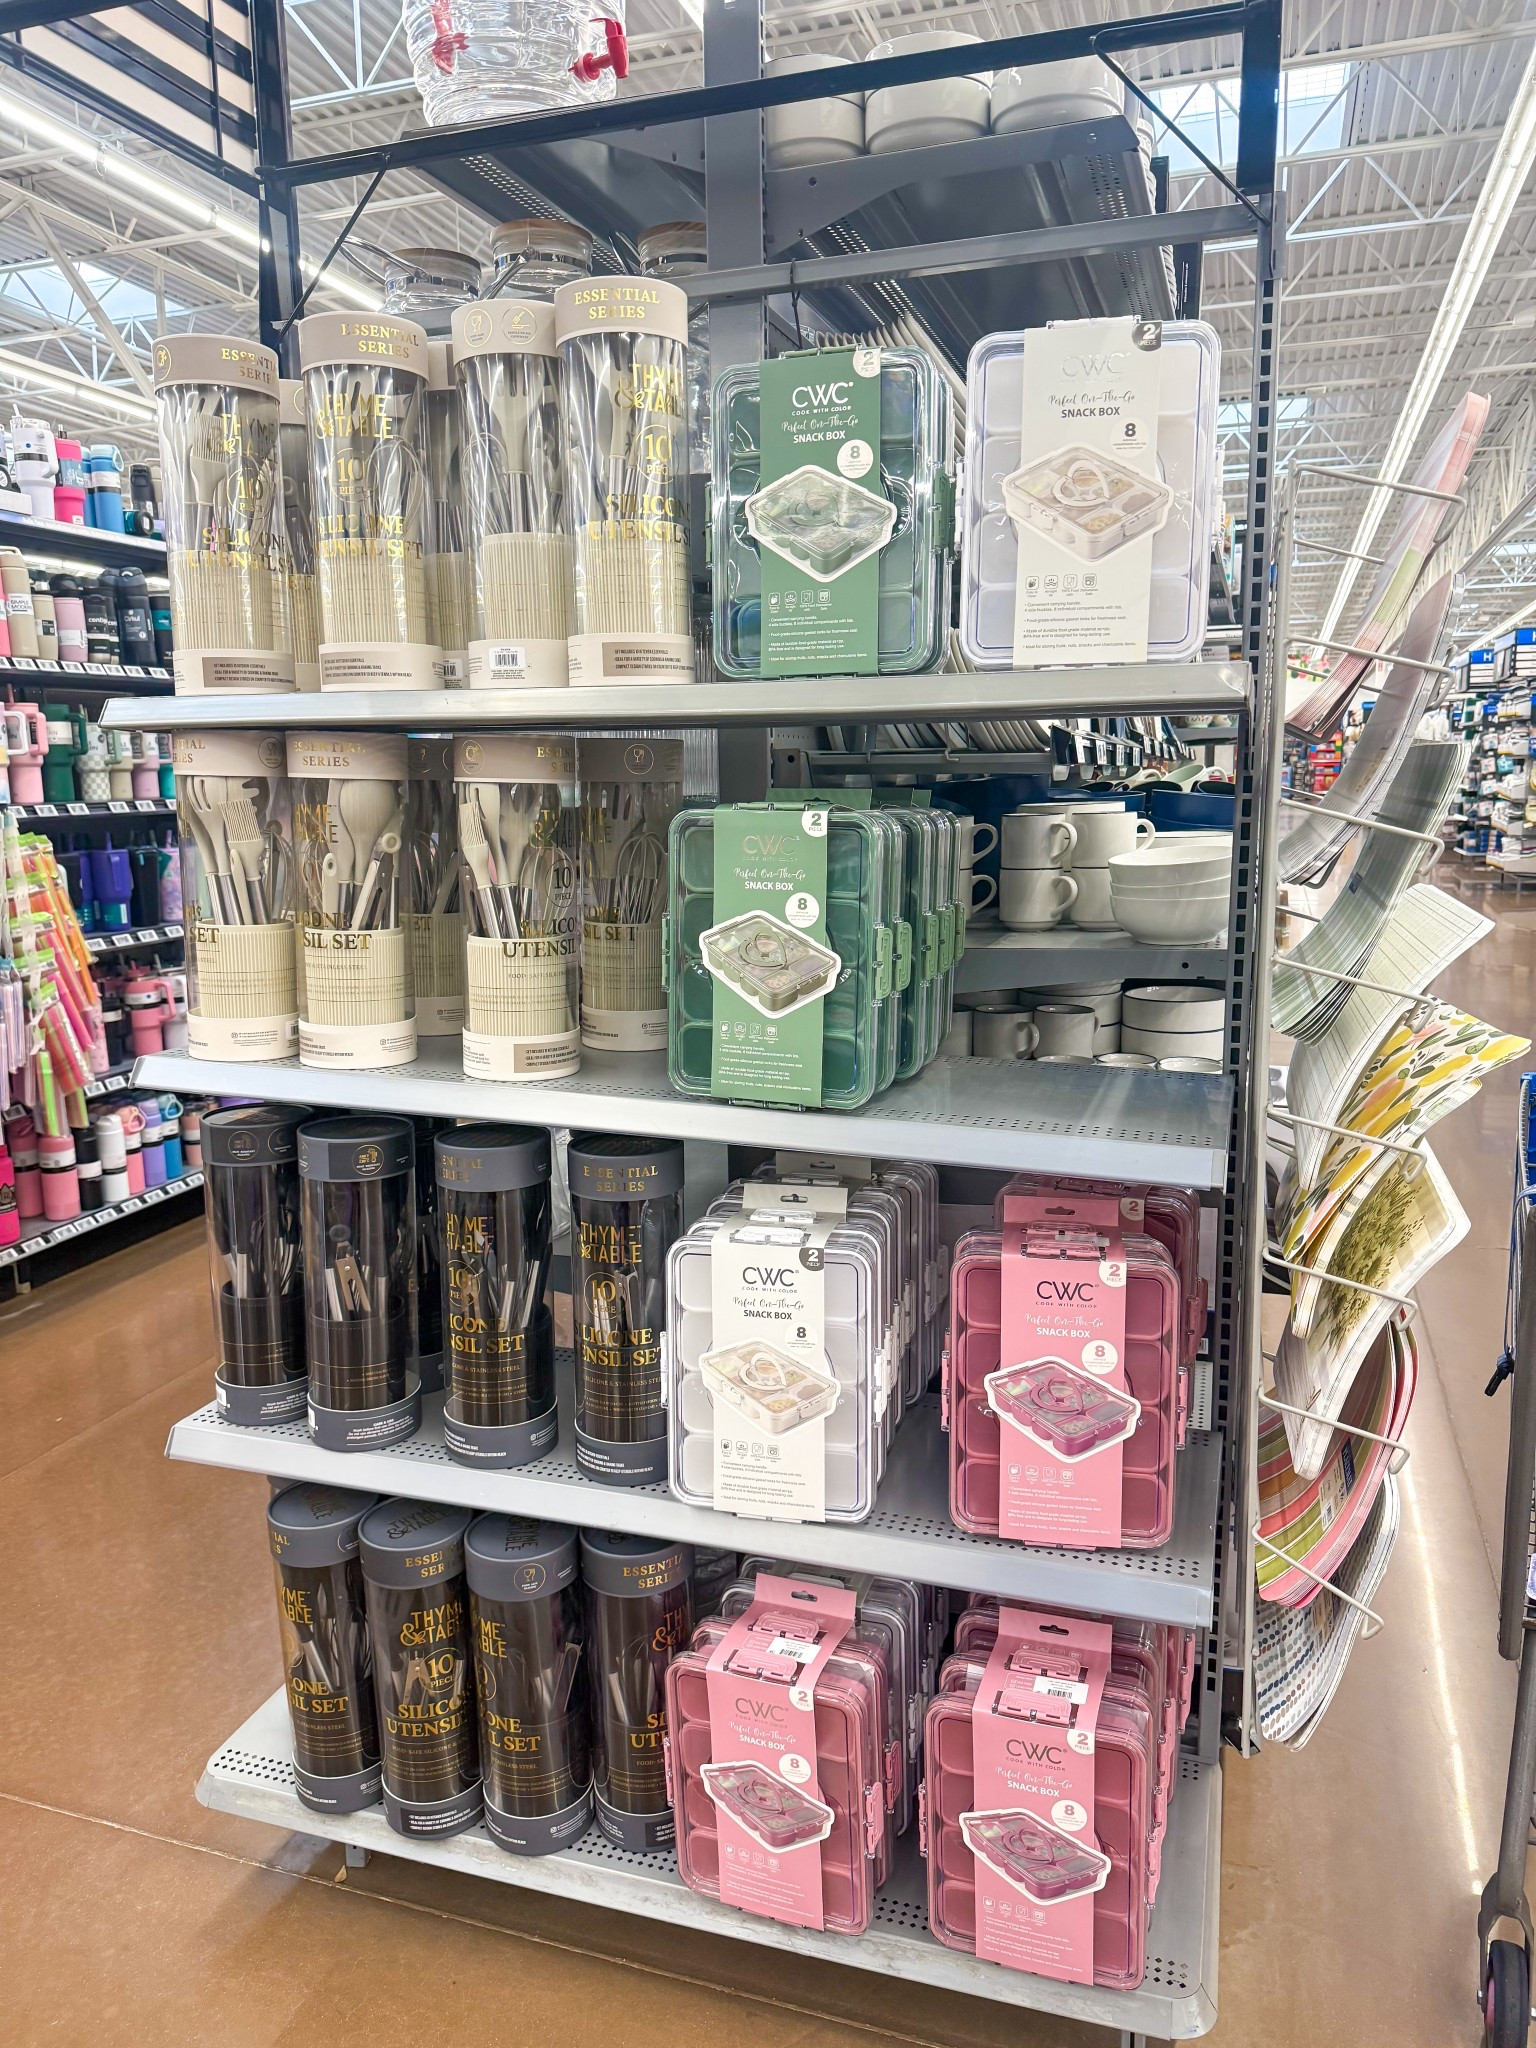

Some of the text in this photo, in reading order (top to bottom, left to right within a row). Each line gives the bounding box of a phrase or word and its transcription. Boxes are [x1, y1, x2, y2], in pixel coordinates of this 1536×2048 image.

[574, 288, 660, 305] ESSENTIAL
[589, 305, 646, 320] SERIES
[341, 323, 419, 347] ESSENTIAL
[1142, 323, 1157, 340] 2
[358, 341, 410, 359] SERIES
[863, 351, 875, 366] 2
[1062, 352, 1125, 377] CWC
[792, 382, 849, 408] CWC
[1048, 389, 1136, 407] Perfect On-The-Go
[323, 393, 386, 417] THYME
[1061, 406, 1121, 419] SNACK BOX
[781, 414, 859, 433] Perfect On-The-Go
[1124, 422, 1136, 437] 8
[793, 430, 846, 443] SNACK BOX
[644, 433, 672, 462] 10
[850, 445, 861, 459] 8
[337, 457, 365, 482] 10
[588, 519, 682, 544] UTENSIL
[1483, 652, 1492, 661] H
[302, 756, 351, 767] SERIES
[810, 813, 821, 826] 2
[743, 835, 796, 856] CWC
[553, 866, 571, 890] 10
[733, 867, 807, 880] Perfect On-The-Go
[744, 881, 794, 891] SNACK BOX
[797, 898, 807, 910] 8
[332, 933, 372, 950] SET
[501, 938, 577, 958] UTENSIL
[596, 1181, 646, 1193] SERIES
[1128, 1200, 1139, 1212] 2
[580, 1222, 640, 1246] THYME
[808, 1249, 819, 1262] 2
[449, 1266, 470, 1288] 10
[742, 1266, 795, 1287] CWC
[1108, 1263, 1121, 1277] 2
[592, 1279, 616, 1302] 10
[1036, 1280, 1094, 1302] CWC
[732, 1296, 805, 1310] Perfect On-The-Go
[743, 1309, 793, 1320] SNACK BOX
[1025, 1313, 1104, 1329] Perfect On-The-Go
[796, 1326, 807, 1338] 8
[1036, 1327, 1091, 1338] SNACK BOX
[486, 1334, 525, 1354] SET
[1094, 1345, 1106, 1358] 8
[502, 1365, 521, 1373] STEEL
[427, 1653, 454, 1679] 10
[798, 1691, 808, 1701] 2
[312, 1697, 349, 1714] SET
[735, 1697, 785, 1722] CWC
[729, 1720, 797, 1744] Perfect On-The-Go
[1077, 1732, 1089, 1745] 2
[503, 1735, 541, 1752] SET
[739, 1734, 786, 1751] SNACK BOX
[1006, 1739, 1062, 1765] CWC
[789, 1758, 800, 1769] 8
[1005, 1756, 1024, 1764] COOK
[1045, 1764, 1066, 1772] COLOR
[995, 1766, 1073, 1789] Perfect On-The-Go
[1007, 1780, 1060, 1798] SNACK BOX
[1064, 1805, 1075, 1816] 8
